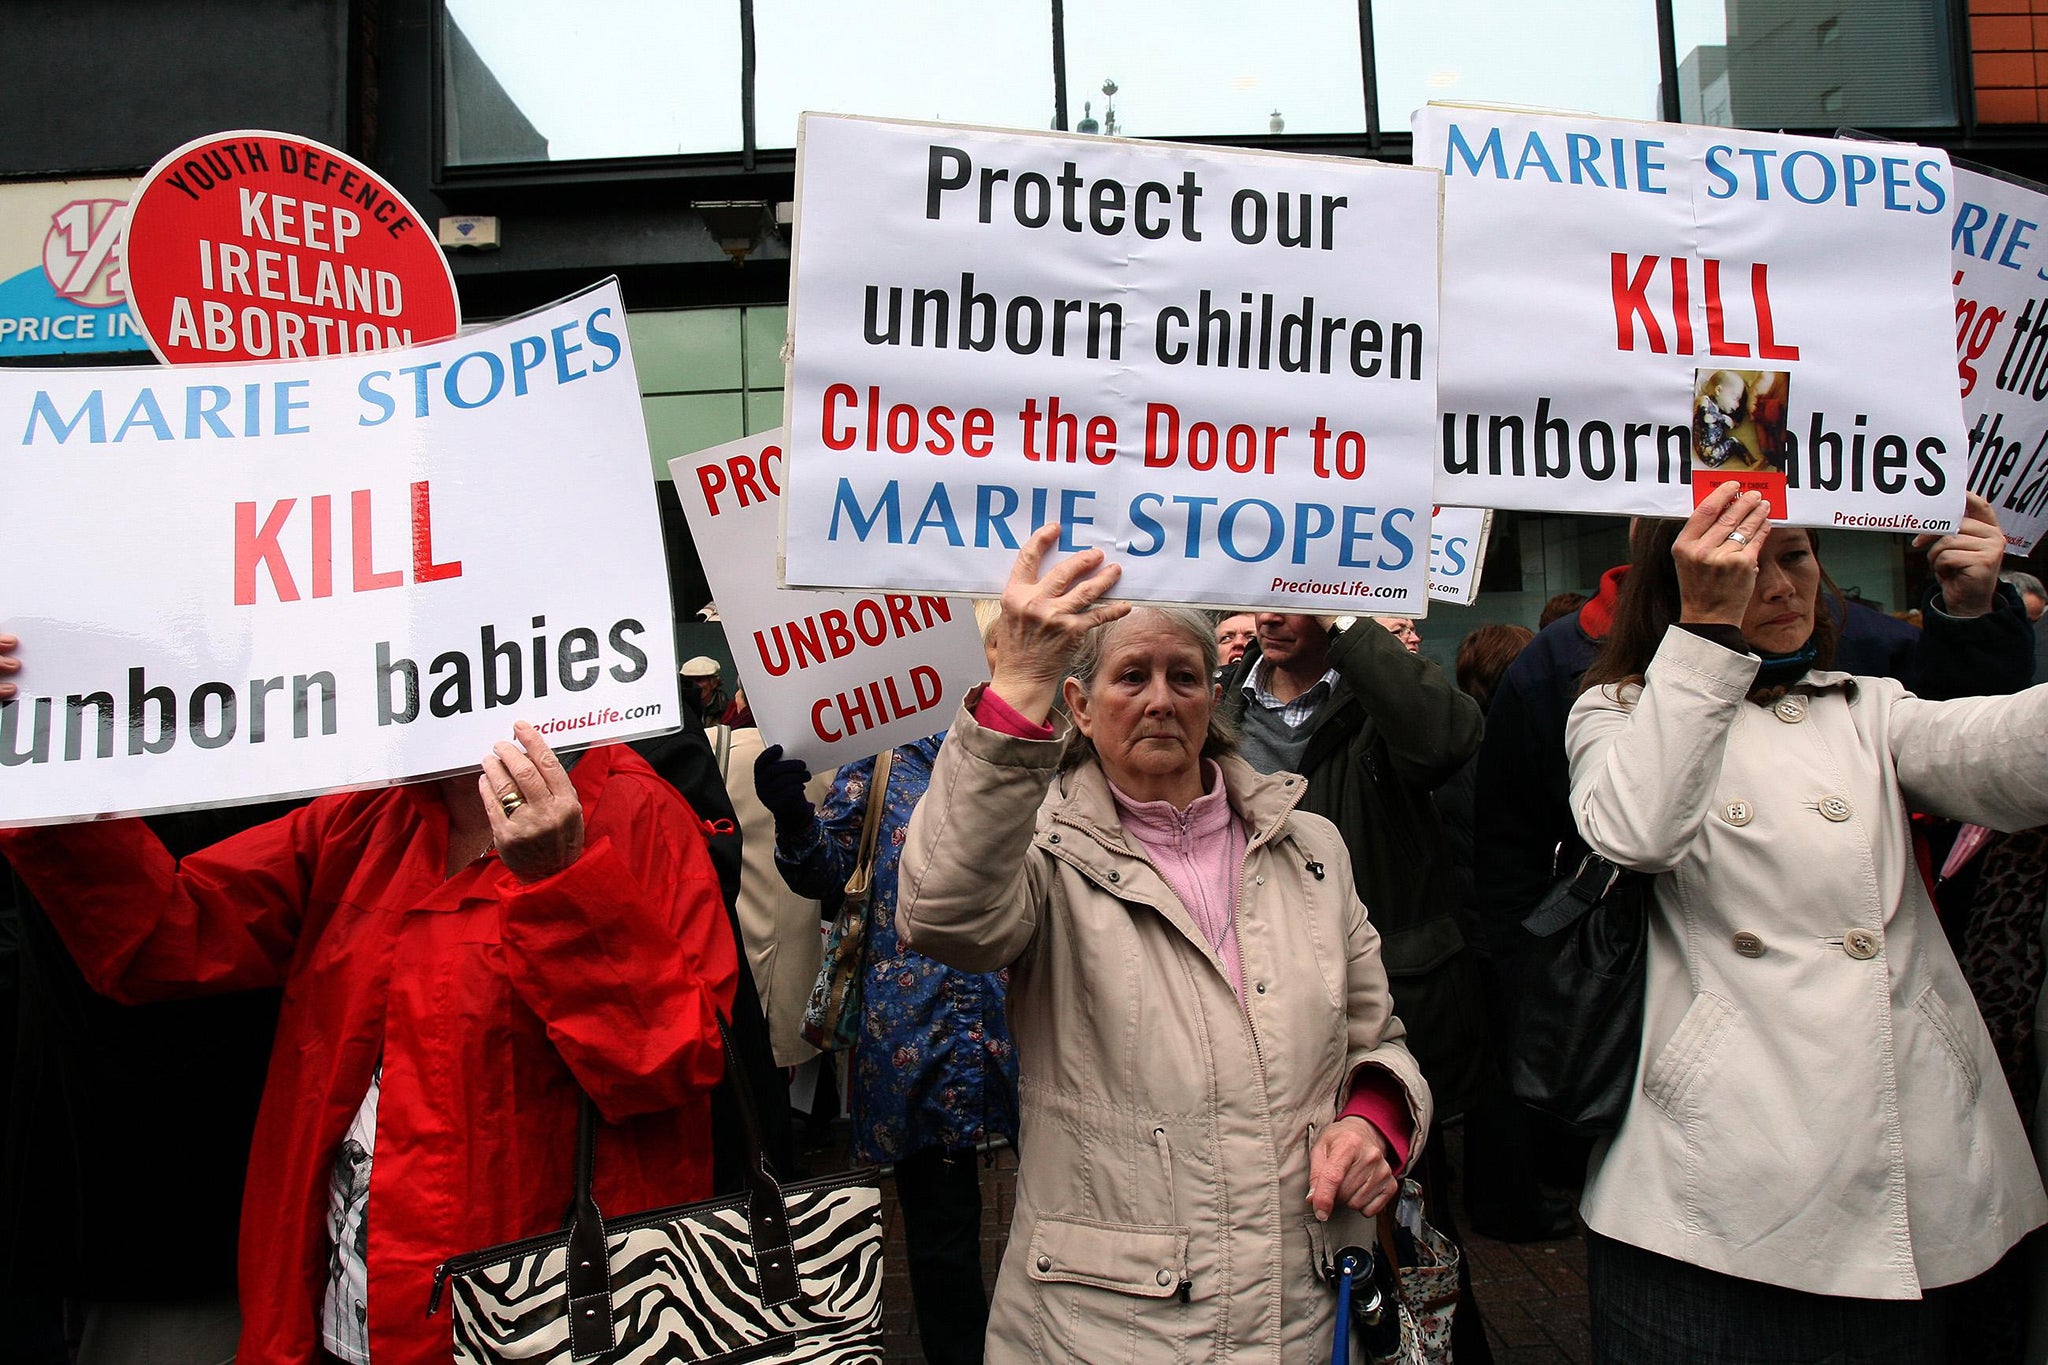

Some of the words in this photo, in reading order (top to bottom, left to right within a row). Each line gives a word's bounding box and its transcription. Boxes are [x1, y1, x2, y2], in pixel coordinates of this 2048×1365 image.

[166, 142, 269, 201] YOUTH
[279, 143, 414, 240] DEFENCE
[926, 145, 1202, 241] Protect
[1231, 188, 1348, 250] our
[1446, 123, 1668, 195] MARIE
[1706, 144, 1946, 215] STOPES
[239, 187, 361, 254] KEEP
[1951, 201, 2038, 270] RIE
[199, 239, 404, 318] IRELAND
[1610, 252, 1800, 361] KILL
[0, 315, 95, 342] PRICE
[863, 271, 1123, 361] unborn
[1156, 289, 1423, 380] children
[23, 379, 309, 446] MARIE
[358, 306, 622, 426] STOPES
[821, 383, 995, 459] Close
[1020, 396, 1118, 465] the
[1144, 402, 1289, 474] Door
[1309, 416, 1366, 480] to
[1443, 396, 1692, 485] unborn
[696, 445, 782, 517] PRO
[828, 477, 1097, 553] MARIE
[1127, 492, 1416, 572] STOPES
[1833, 511, 1952, 531] PreciousLife.com
[234, 479, 463, 606] KILL
[1270, 577, 1408, 599] PreciousLife.com
[753, 595, 952, 677] UNBORN
[0, 666, 338, 767] unborn
[375, 614, 648, 727] babies
[533, 703, 662, 735] ciousLife.com
[811, 665, 943, 742] CHILD
